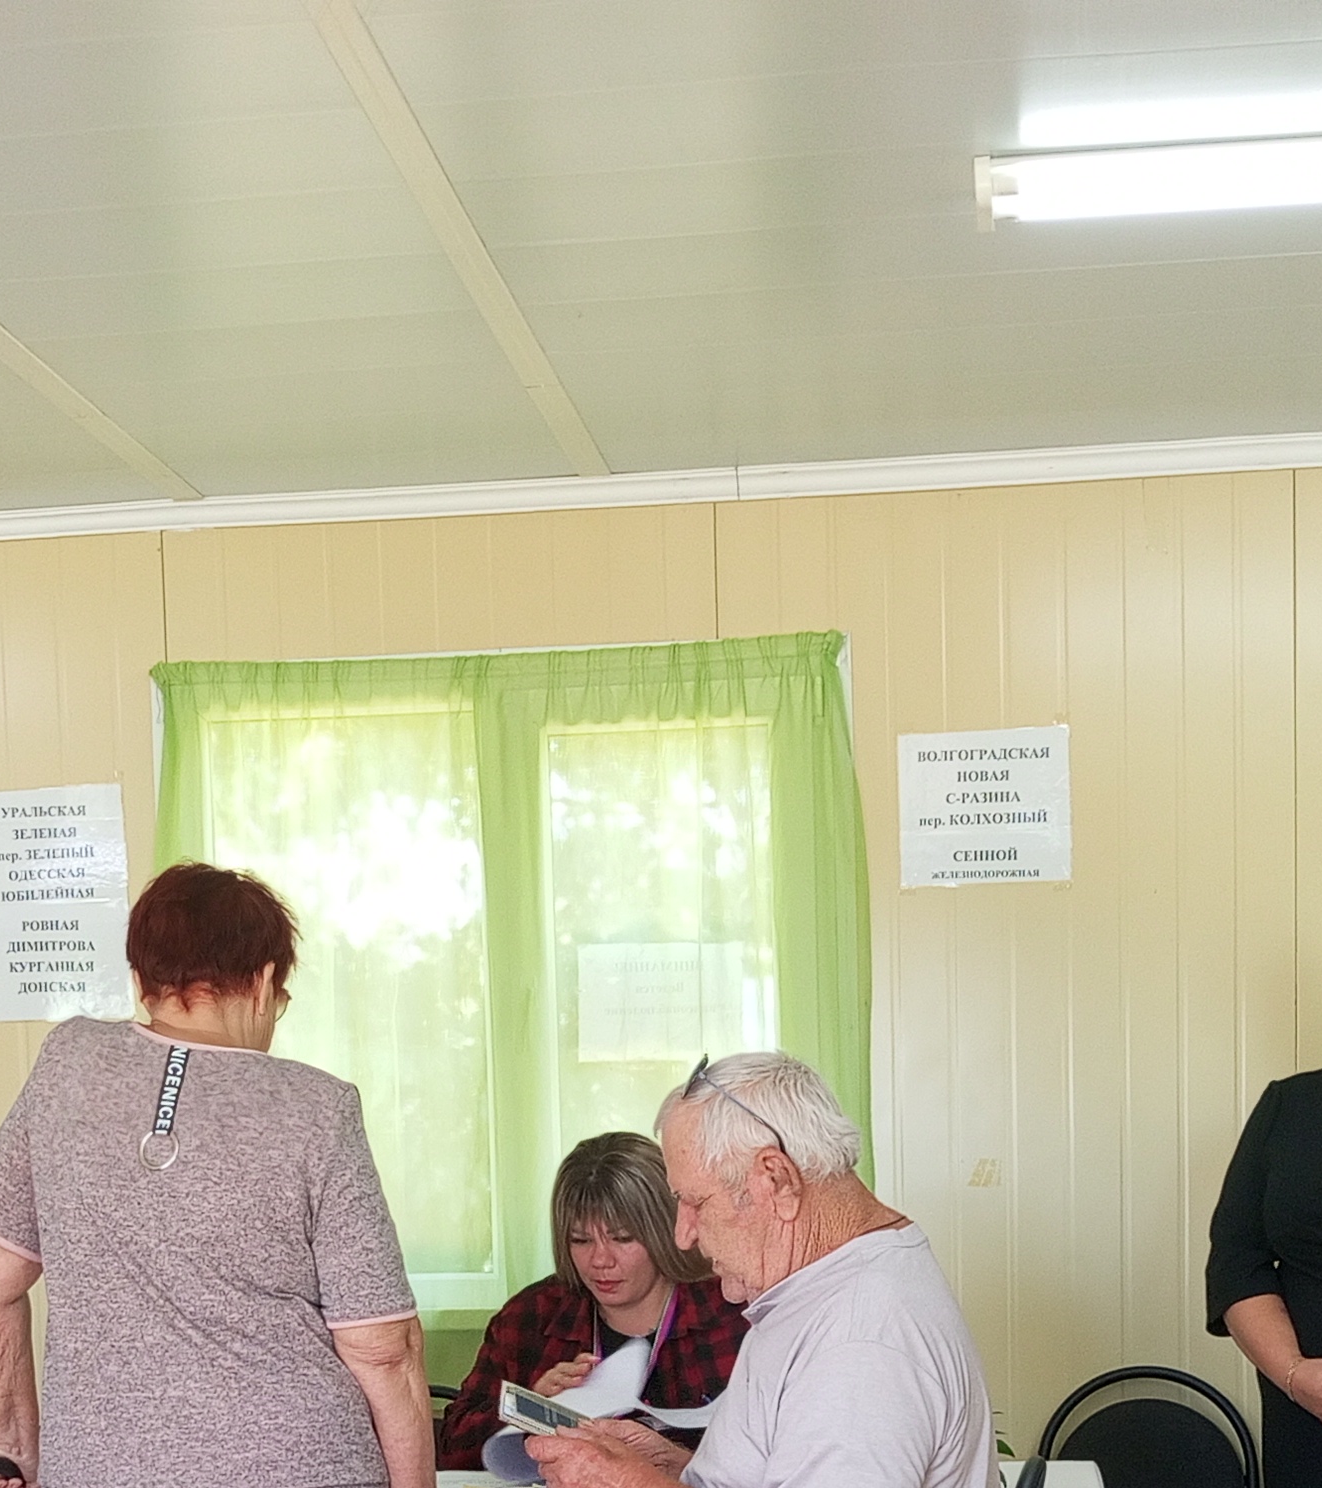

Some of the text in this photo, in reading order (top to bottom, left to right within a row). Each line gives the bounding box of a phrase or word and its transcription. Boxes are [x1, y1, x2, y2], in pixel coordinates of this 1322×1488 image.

[917, 747, 1050, 762] ВОЛГОГРАДСКАЯ
[957, 770, 1010, 782] НОВАЯ
[945, 791, 1021, 804] С-РАЗИНА
[1, 805, 87, 819] УРАЛЬСКАЯ
[919, 809, 1048, 829] пер. КОЛХОЗНЫЙ
[12, 827, 77, 840] ЗЕЛЕНАЯ
[25, 844, 95, 861] ЗЕЛЕНЫЙ
[953, 847, 1018, 862] СЕННОЙ
[9, 867, 85, 882] ОДЕССКАЯ
[931, 869, 1040, 880] ЖЕЛЕЗНОДОРОЖНАЯ
[1, 887, 94, 902] ЮБИЛЕЙНАЯ
[22, 920, 79, 932] РОВНАЯ
[6, 940, 95, 954] ДИМИТРОВА
[9, 961, 94, 973] КУРГАННАЯ
[18, 981, 86, 994] ДОНСКАЯ
